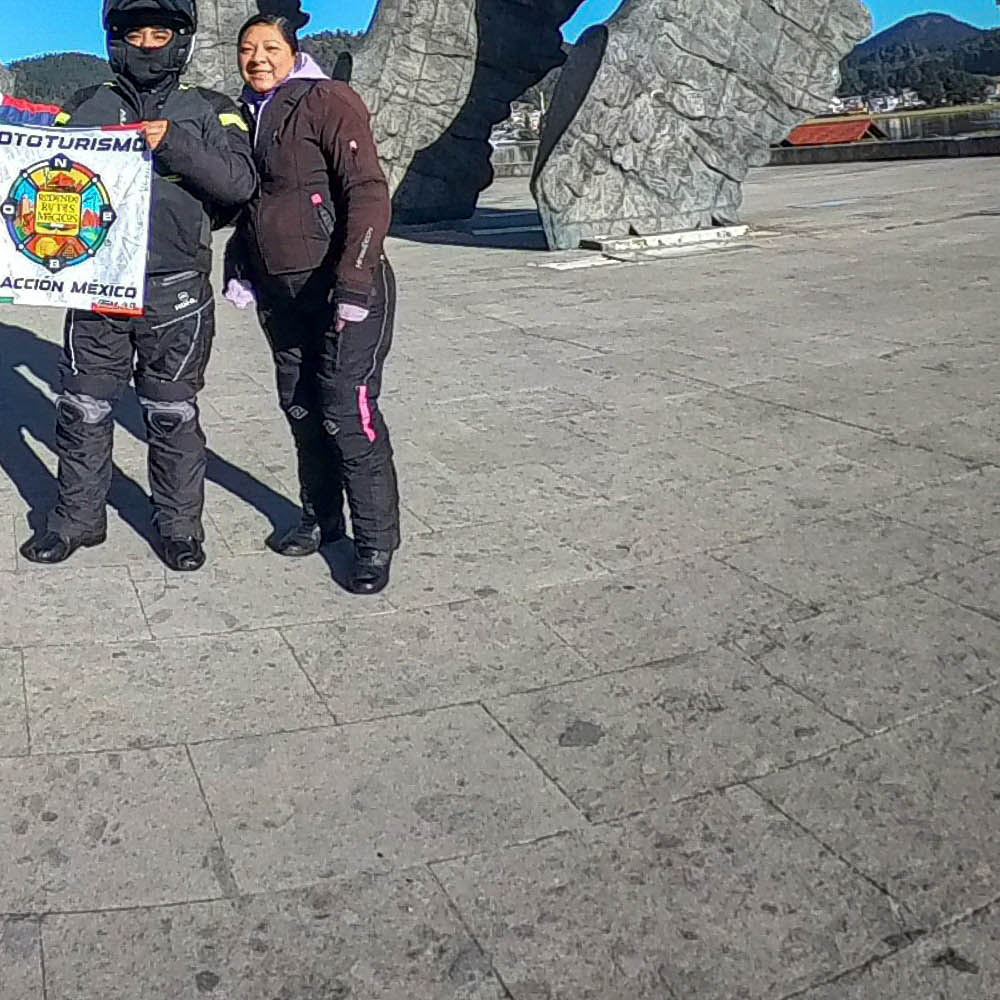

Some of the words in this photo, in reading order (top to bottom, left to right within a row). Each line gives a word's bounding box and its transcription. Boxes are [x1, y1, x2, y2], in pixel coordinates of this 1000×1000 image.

[54, 157, 67, 168] N
[0, 275, 64, 295] ACCIÓN
[70, 279, 137, 299] MÉXICO
